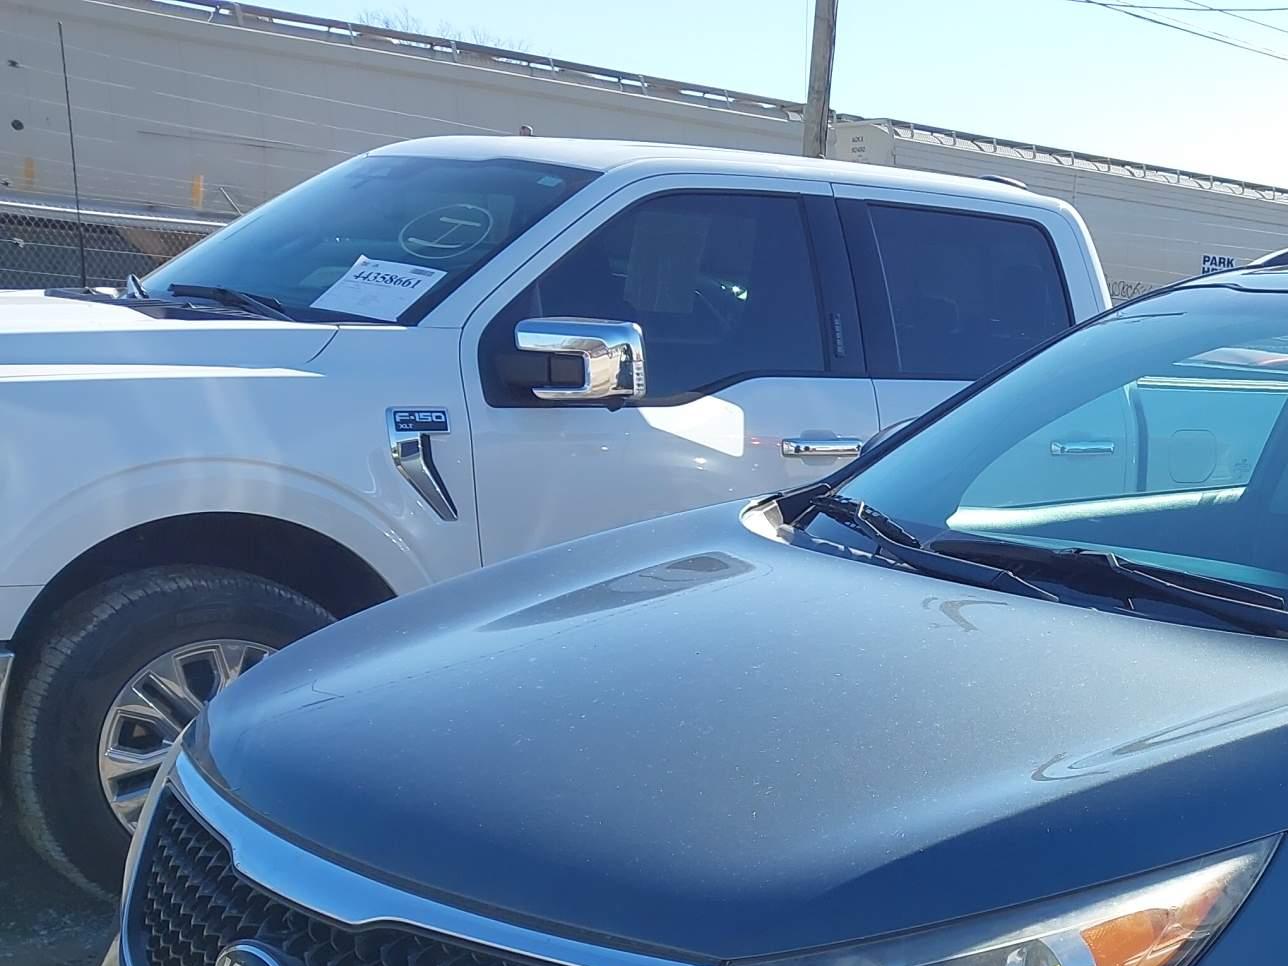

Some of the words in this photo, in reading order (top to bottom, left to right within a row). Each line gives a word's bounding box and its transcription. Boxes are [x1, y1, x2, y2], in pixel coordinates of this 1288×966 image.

[1202, 255, 1235, 268] PARK
[353, 270, 423, 289] 44358661
[395, 412, 446, 422] F-150
